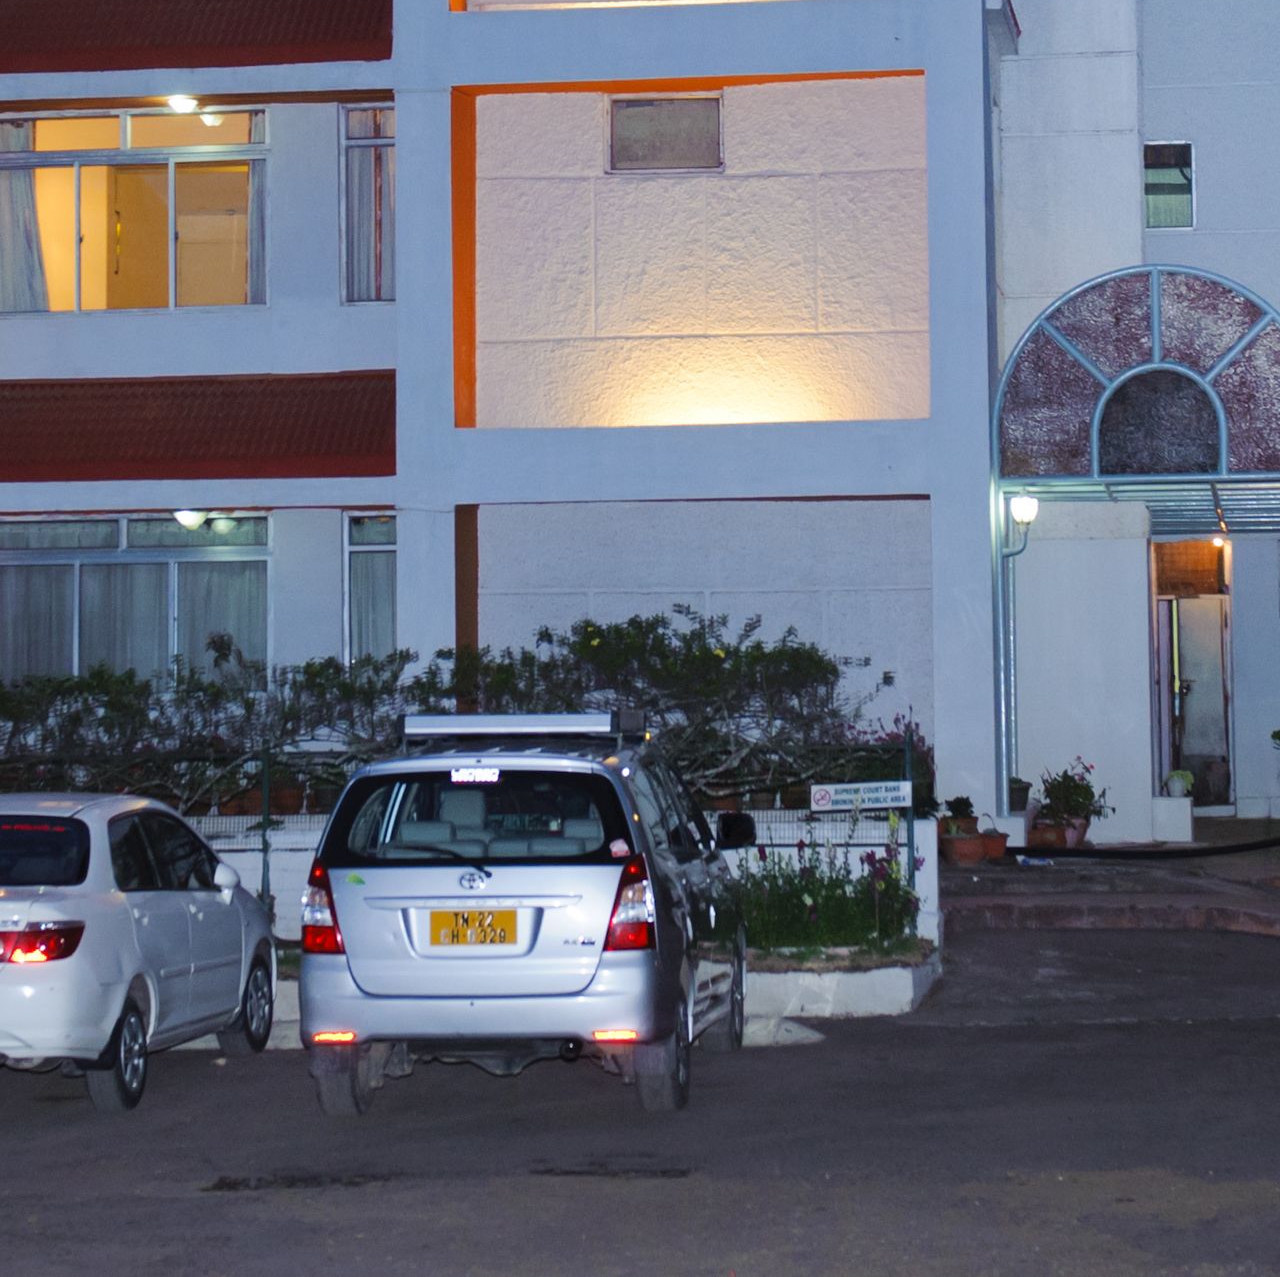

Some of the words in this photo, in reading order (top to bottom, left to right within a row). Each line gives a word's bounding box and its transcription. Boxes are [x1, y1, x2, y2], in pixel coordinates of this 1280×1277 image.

[862, 786, 883, 794] COURT
[885, 785, 900, 793] BANS
[867, 796, 889, 804] PUBLIC
[890, 795, 906, 803] AREA
